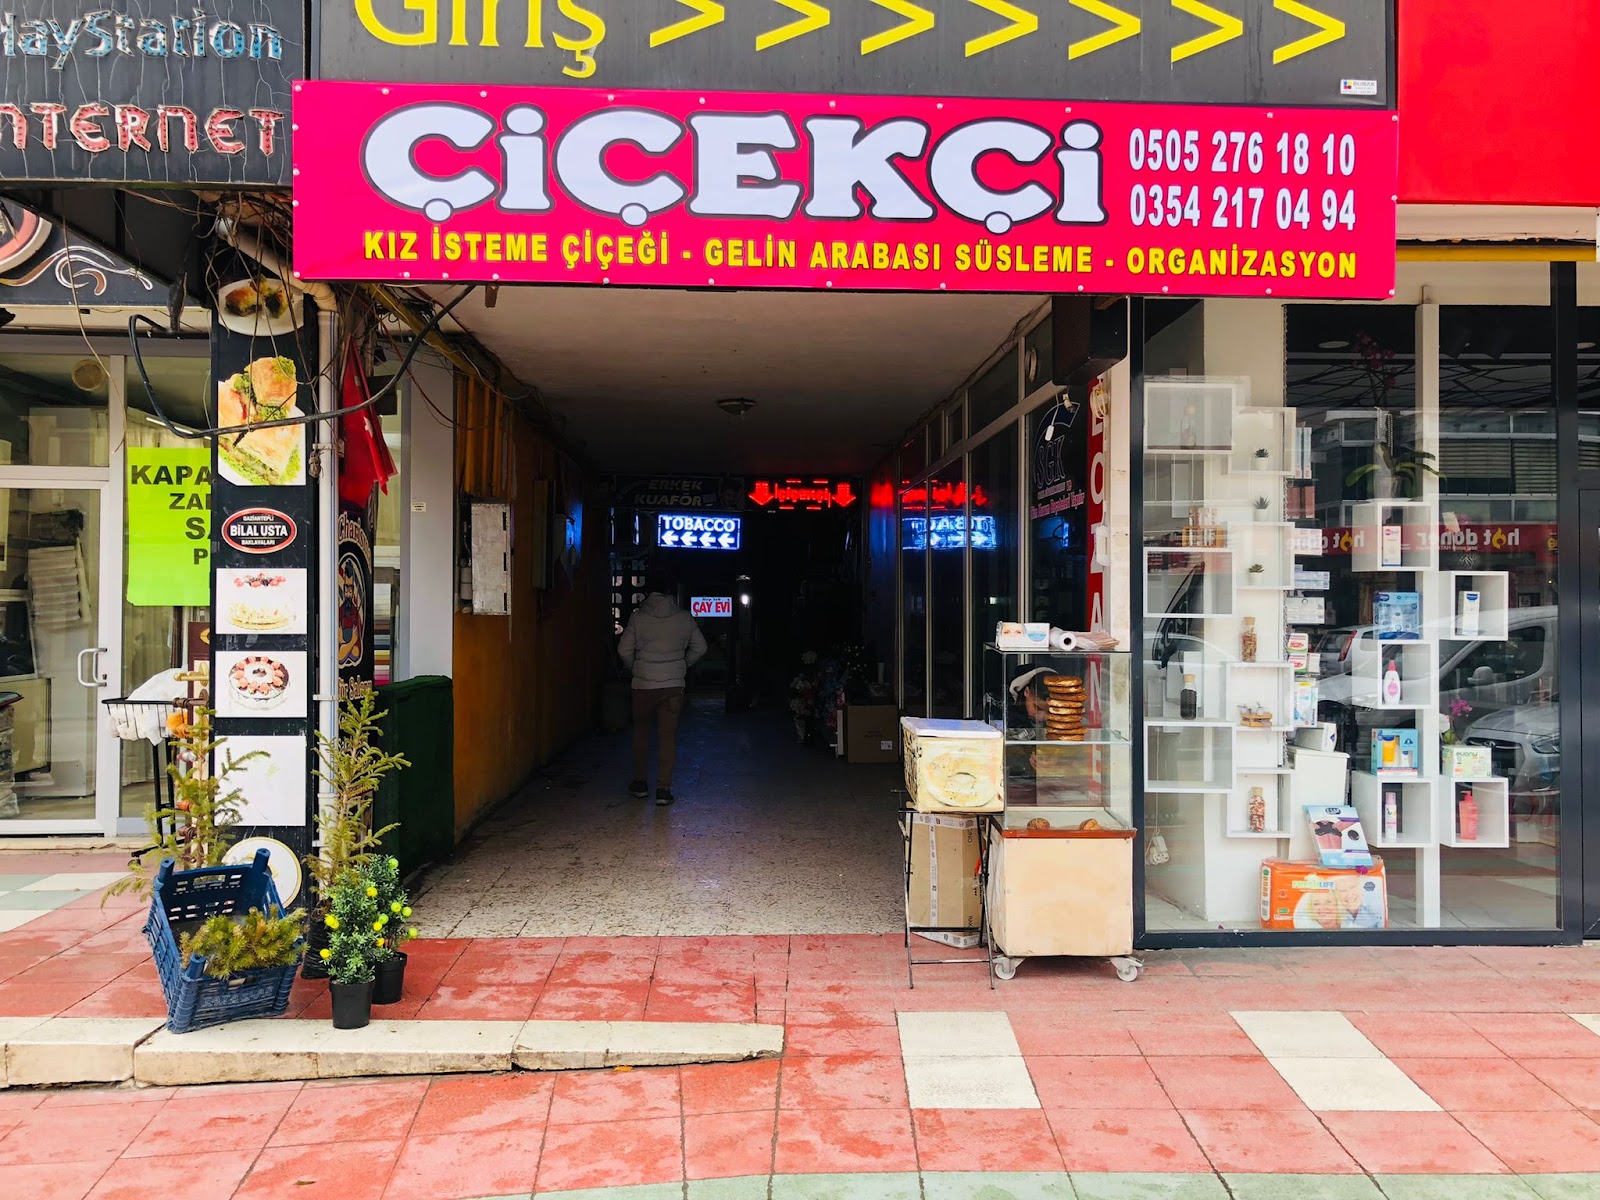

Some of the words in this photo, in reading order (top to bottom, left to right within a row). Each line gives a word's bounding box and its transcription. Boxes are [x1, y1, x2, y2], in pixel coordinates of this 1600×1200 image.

[0, 8, 283, 70] layStation
[1129, 127, 1200, 173] 0505
[1211, 130, 1264, 174] 276
[1276, 132, 1310, 176] 18
[1322, 133, 1356, 177] 10
[1129, 184, 1200, 228] 0354
[1212, 187, 1264, 229] 217
[1276, 188, 1311, 230] 04
[1321, 189, 1356, 231] 94
[363, 231, 418, 260] KIZ
[432, 226, 548, 263] İSTEME
[562, 229, 669, 270] ÇİÇEĞİ
[704, 233, 796, 268] GELİN
[809, 240, 941, 271] ARABASI
[954, 238, 1094, 273] SÜSLEME
[1126, 243, 1358, 279] ORGANİZASYON
[648, 479, 704, 491] ERKEK
[633, 492, 702, 507] KUAFÖR
[260, 524, 288, 537] USTA
[662, 516, 736, 532] TOBACCO
[693, 601, 713, 616] ÇAY
[715, 598, 731, 613] EVİ
